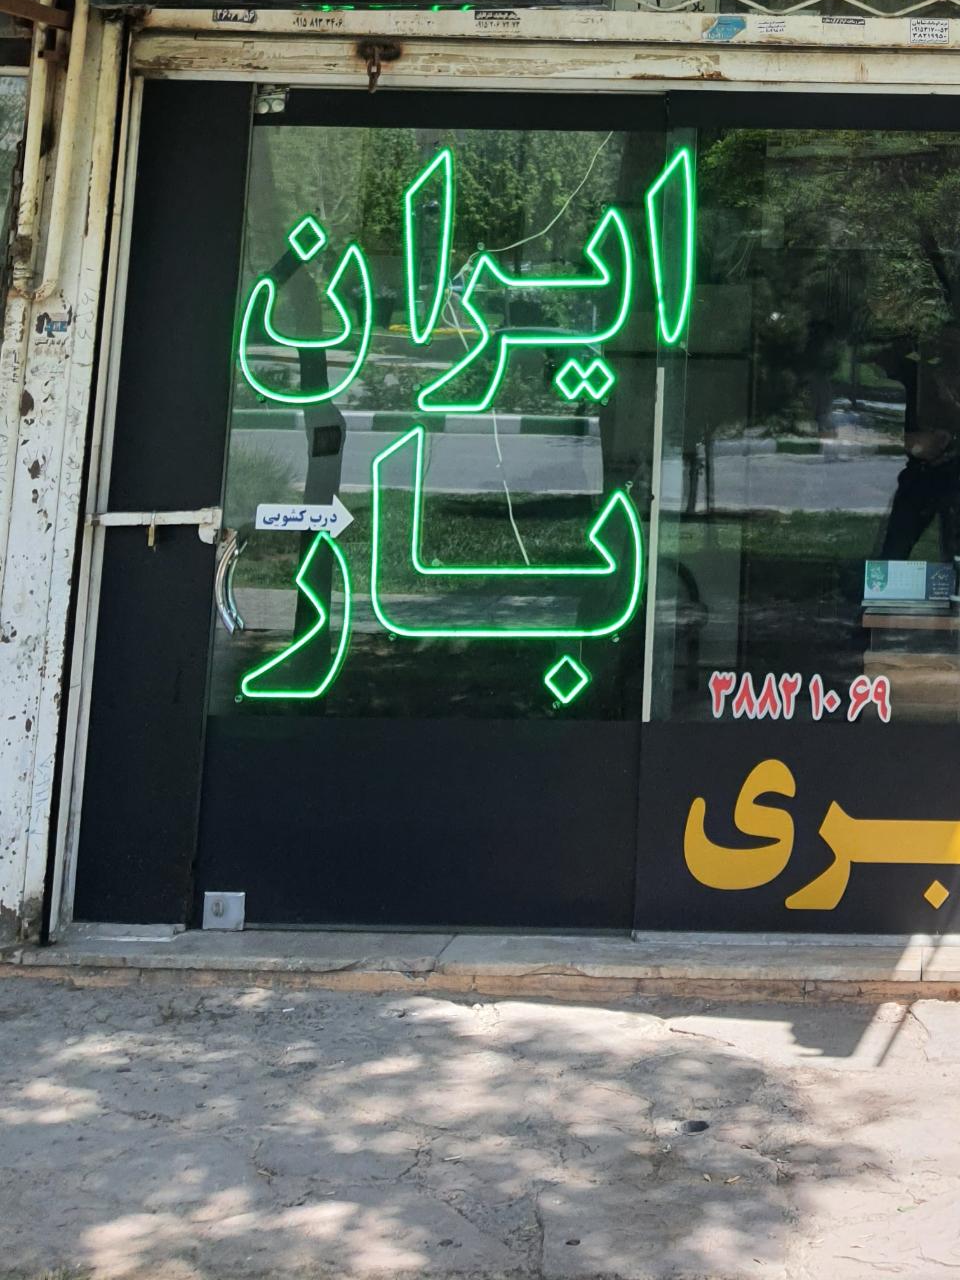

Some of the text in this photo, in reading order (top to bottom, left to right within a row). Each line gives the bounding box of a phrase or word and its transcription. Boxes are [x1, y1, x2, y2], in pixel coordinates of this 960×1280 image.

[237, 146, 697, 413] ایران
[239, 424, 645, 706] بار
[262, 509, 338, 528] درب کشویی
